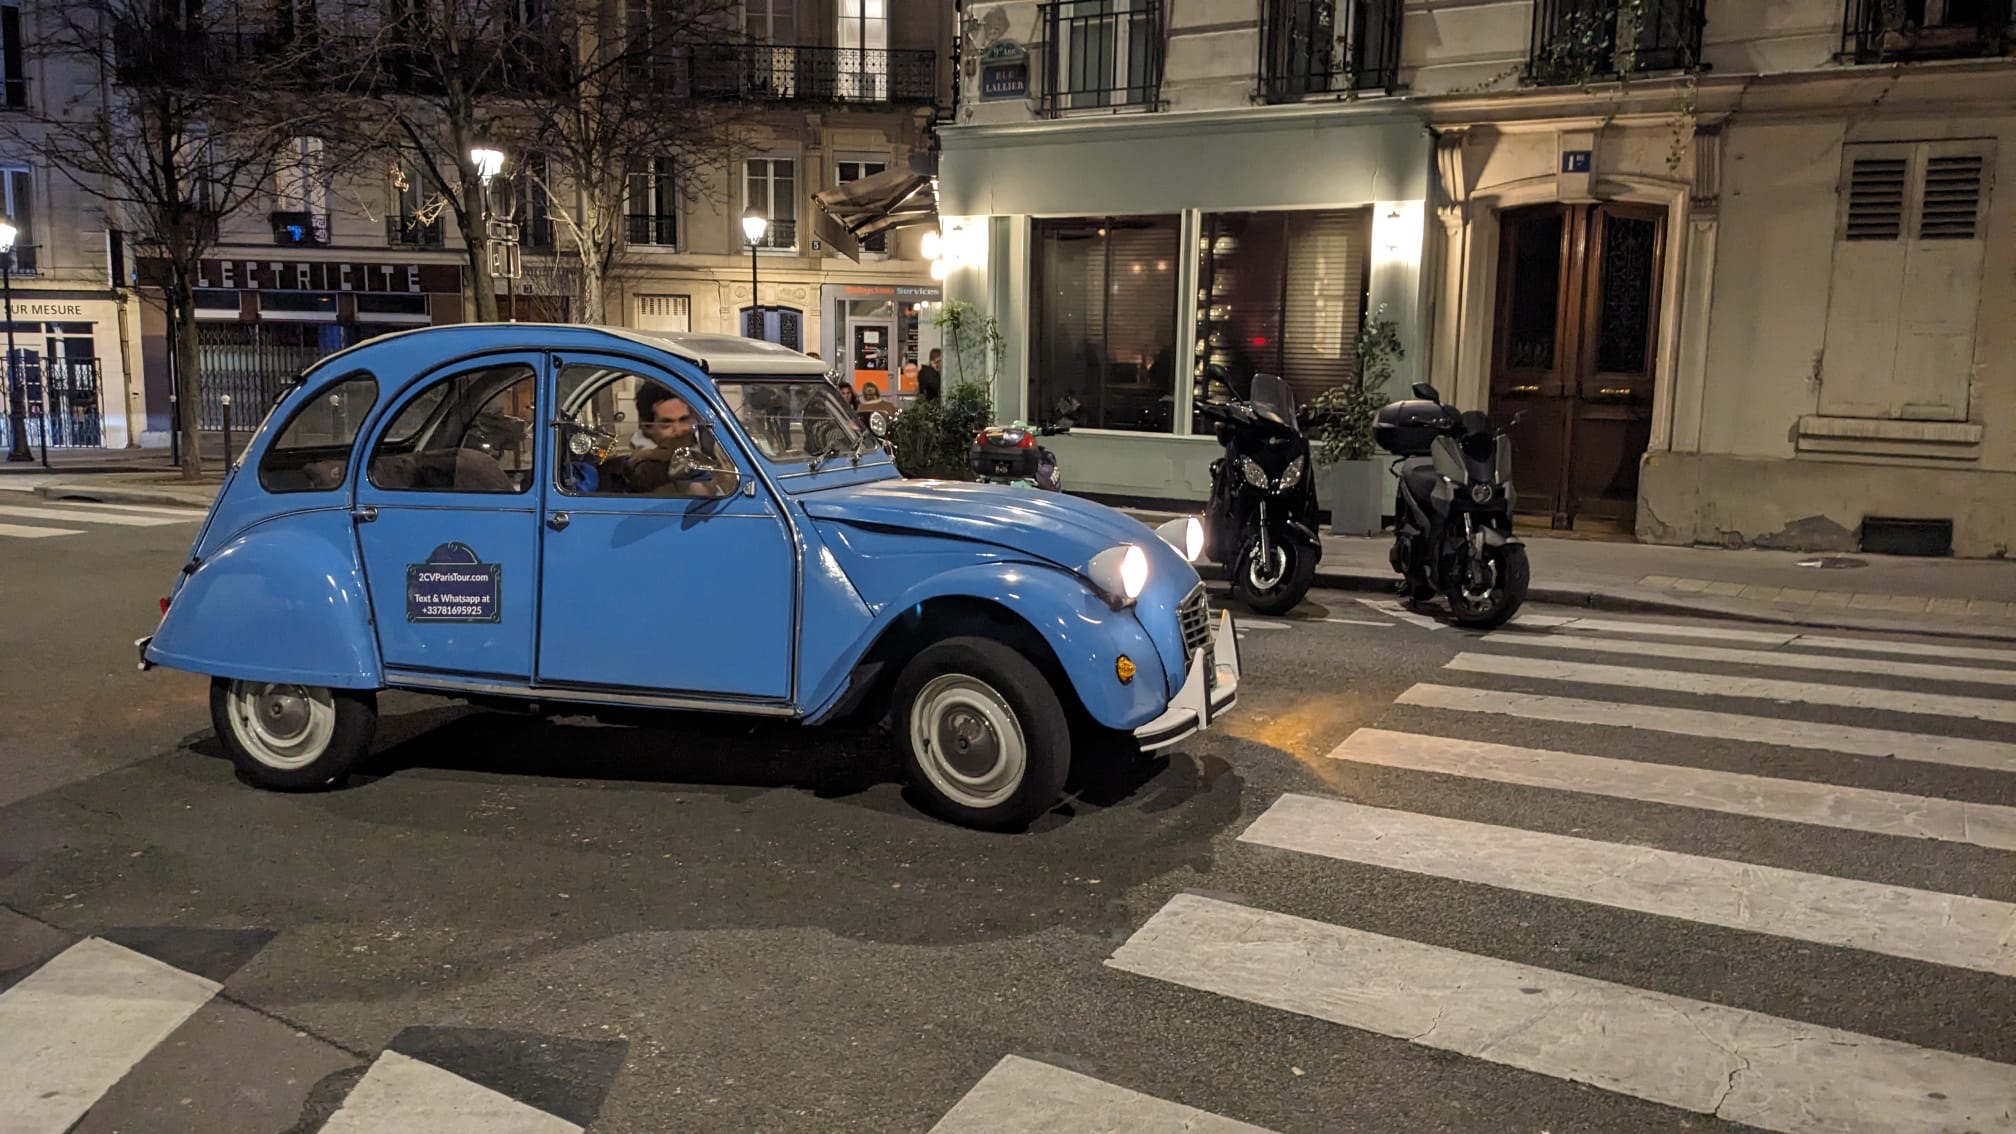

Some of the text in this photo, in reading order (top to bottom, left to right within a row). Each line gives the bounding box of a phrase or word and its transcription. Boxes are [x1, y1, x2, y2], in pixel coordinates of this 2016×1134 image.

[985, 81, 1024, 92] LALLIER
[896, 287, 940, 296] Services
[31, 304, 82, 316] MESURE
[418, 572, 489, 582] 2CVParisTour.com
[414, 593, 490, 604] Text & Whatsapp at
[422, 606, 482, 615] +33781695925
